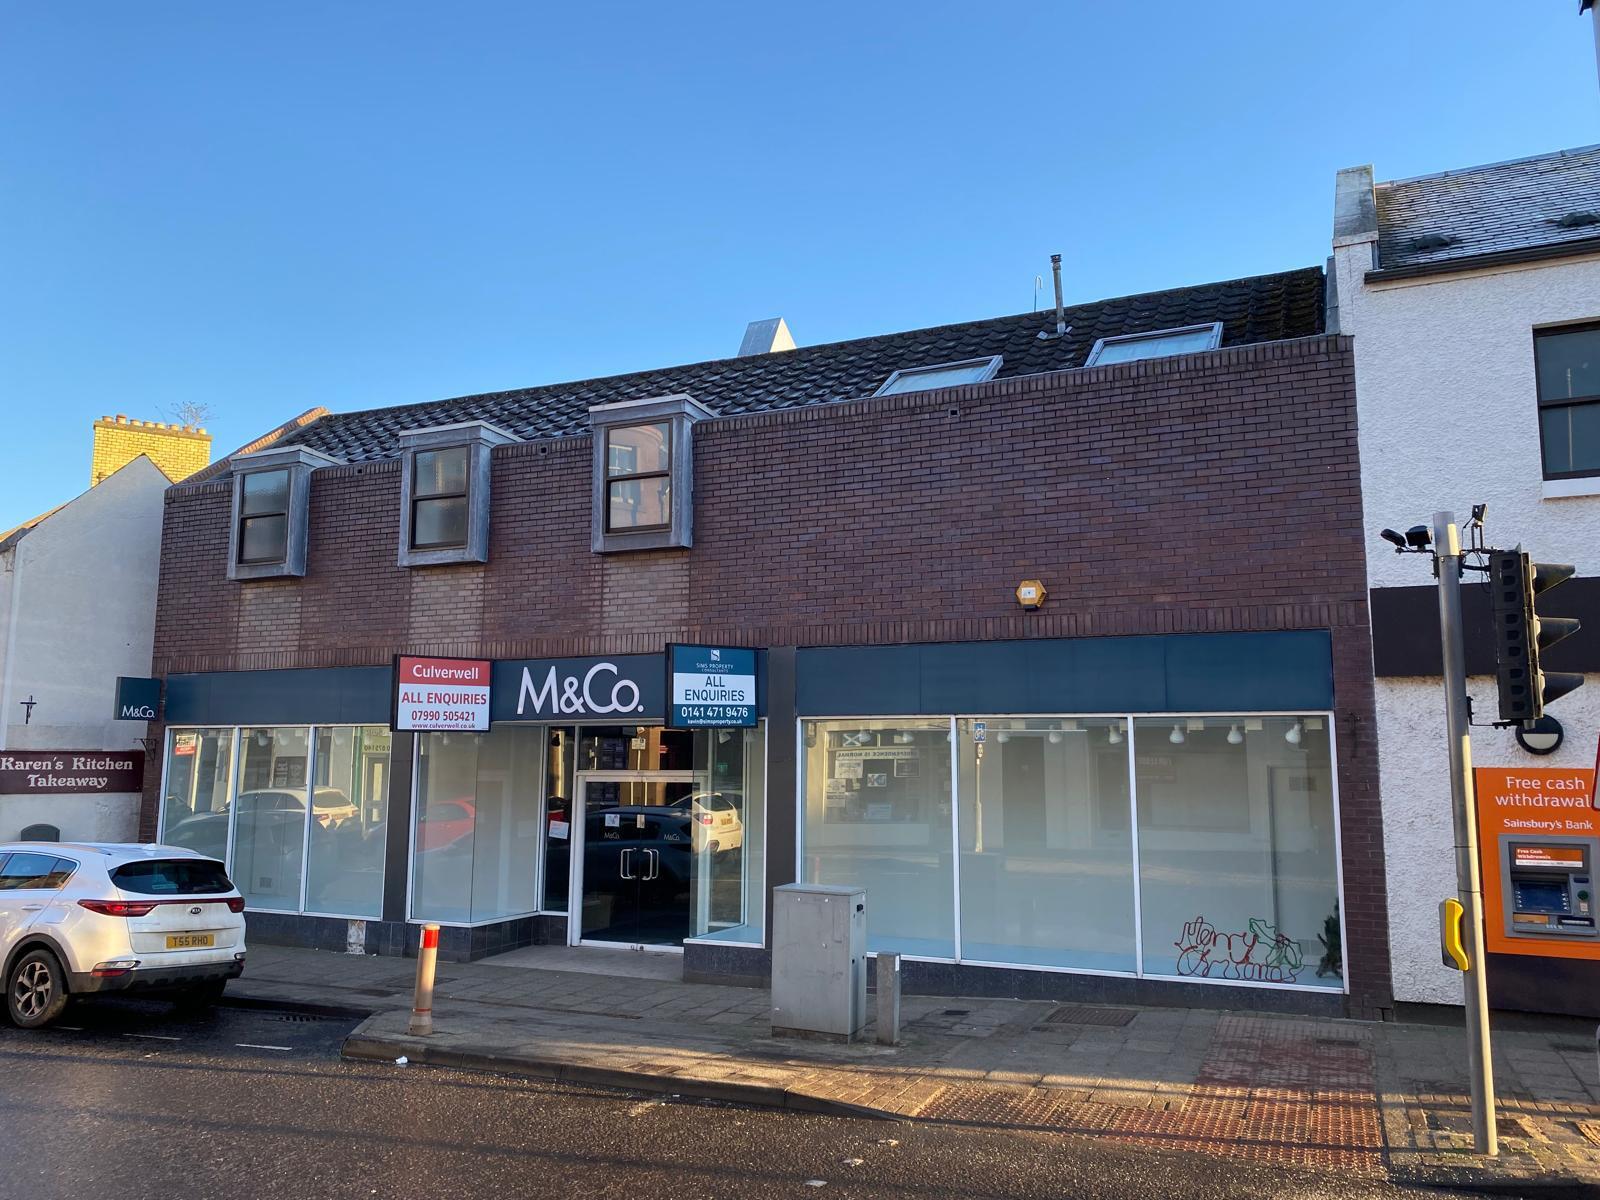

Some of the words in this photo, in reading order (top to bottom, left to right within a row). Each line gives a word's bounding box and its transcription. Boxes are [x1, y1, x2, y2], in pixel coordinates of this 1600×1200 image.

[413, 664, 478, 679] Culverwell
[517, 662, 644, 714] M&Co.
[705, 676, 725, 687] ALL
[402, 692, 423, 703] ALL
[427, 693, 486, 705] ENQUIRIES
[685, 689, 744, 701] ENQUIRIES
[122, 705, 154, 718] M&Co.
[411, 711, 440, 721] 07990
[442, 712, 475, 721] 505421
[681, 707, 704, 717] 0141
[707, 707, 723, 717] 471
[725, 707, 748, 717] 9476
[1, 757, 63, 770] Karen's
[72, 757, 133, 770] Kitchen
[27, 774, 108, 788] Takeaway
[1506, 776, 1541, 789] Free
[1546, 777, 1585, 790] cash
[1495, 793, 1591, 807] withdrawal
[1504, 818, 1562, 830] Sainsbury's
[1565, 820, 1593, 830] Bank
